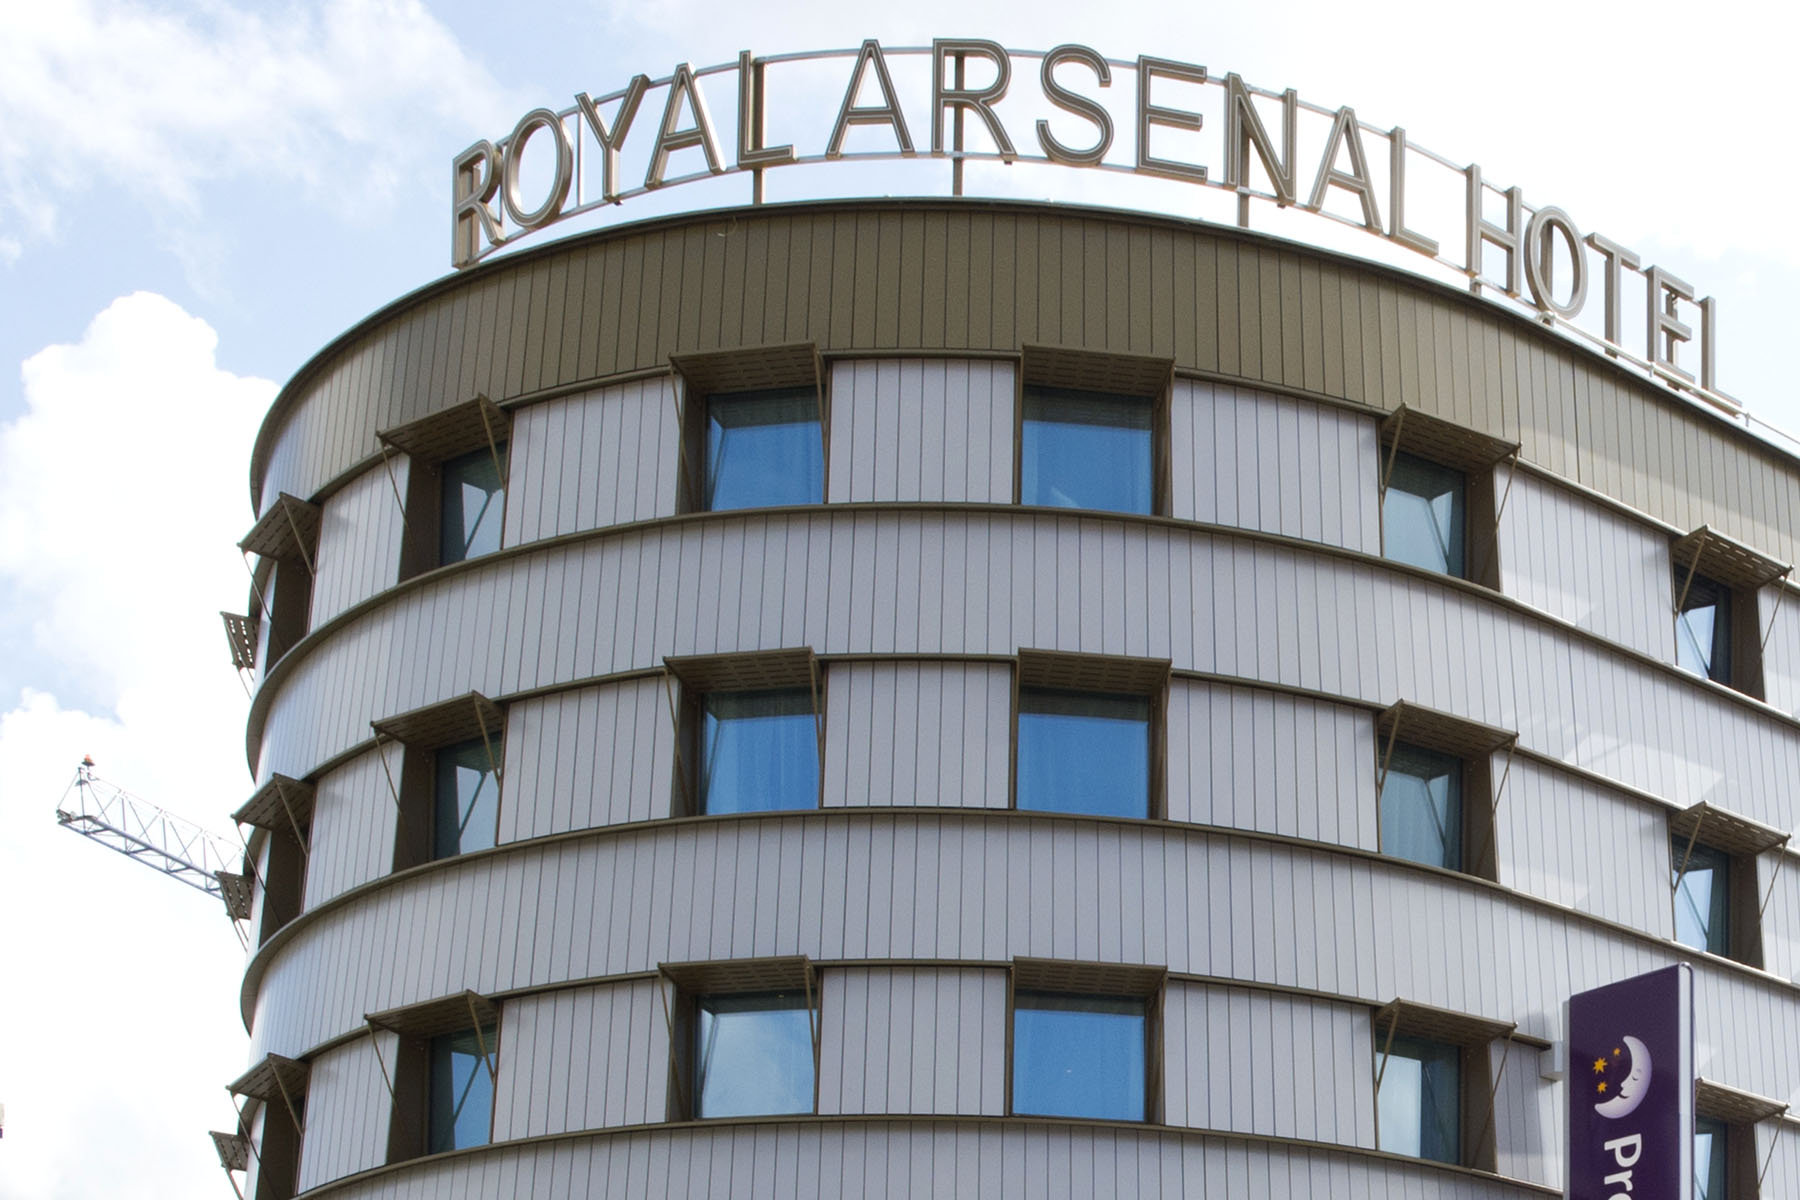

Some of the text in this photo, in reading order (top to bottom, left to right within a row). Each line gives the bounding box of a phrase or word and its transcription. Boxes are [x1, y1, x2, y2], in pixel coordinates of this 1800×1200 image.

[452, 38, 1742, 412] ROYAL ARSENAL HOTEL
